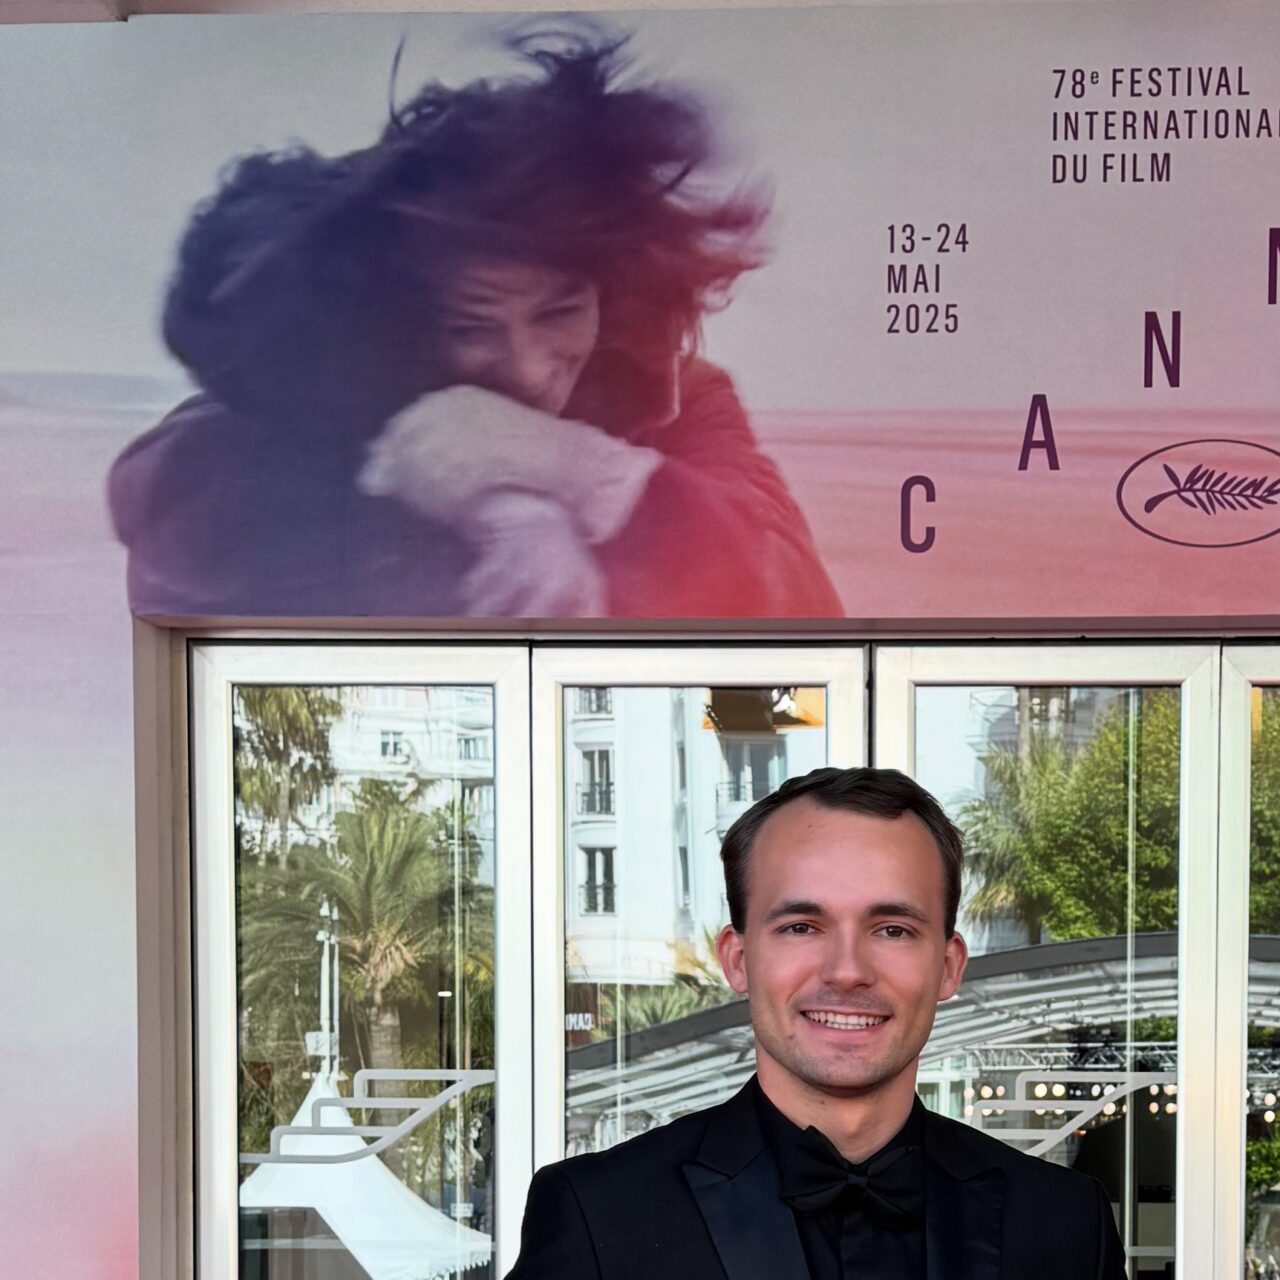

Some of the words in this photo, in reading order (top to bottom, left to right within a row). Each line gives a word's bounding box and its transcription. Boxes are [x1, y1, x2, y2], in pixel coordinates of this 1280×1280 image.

[1112, 66, 1250, 98] FESTIVAL
[1052, 154, 1087, 184] DU
[1103, 153, 1171, 184] FILM
[888, 223, 969, 253] 13-24
[888, 264, 941, 293] MAI
[887, 304, 959, 334] 2025
